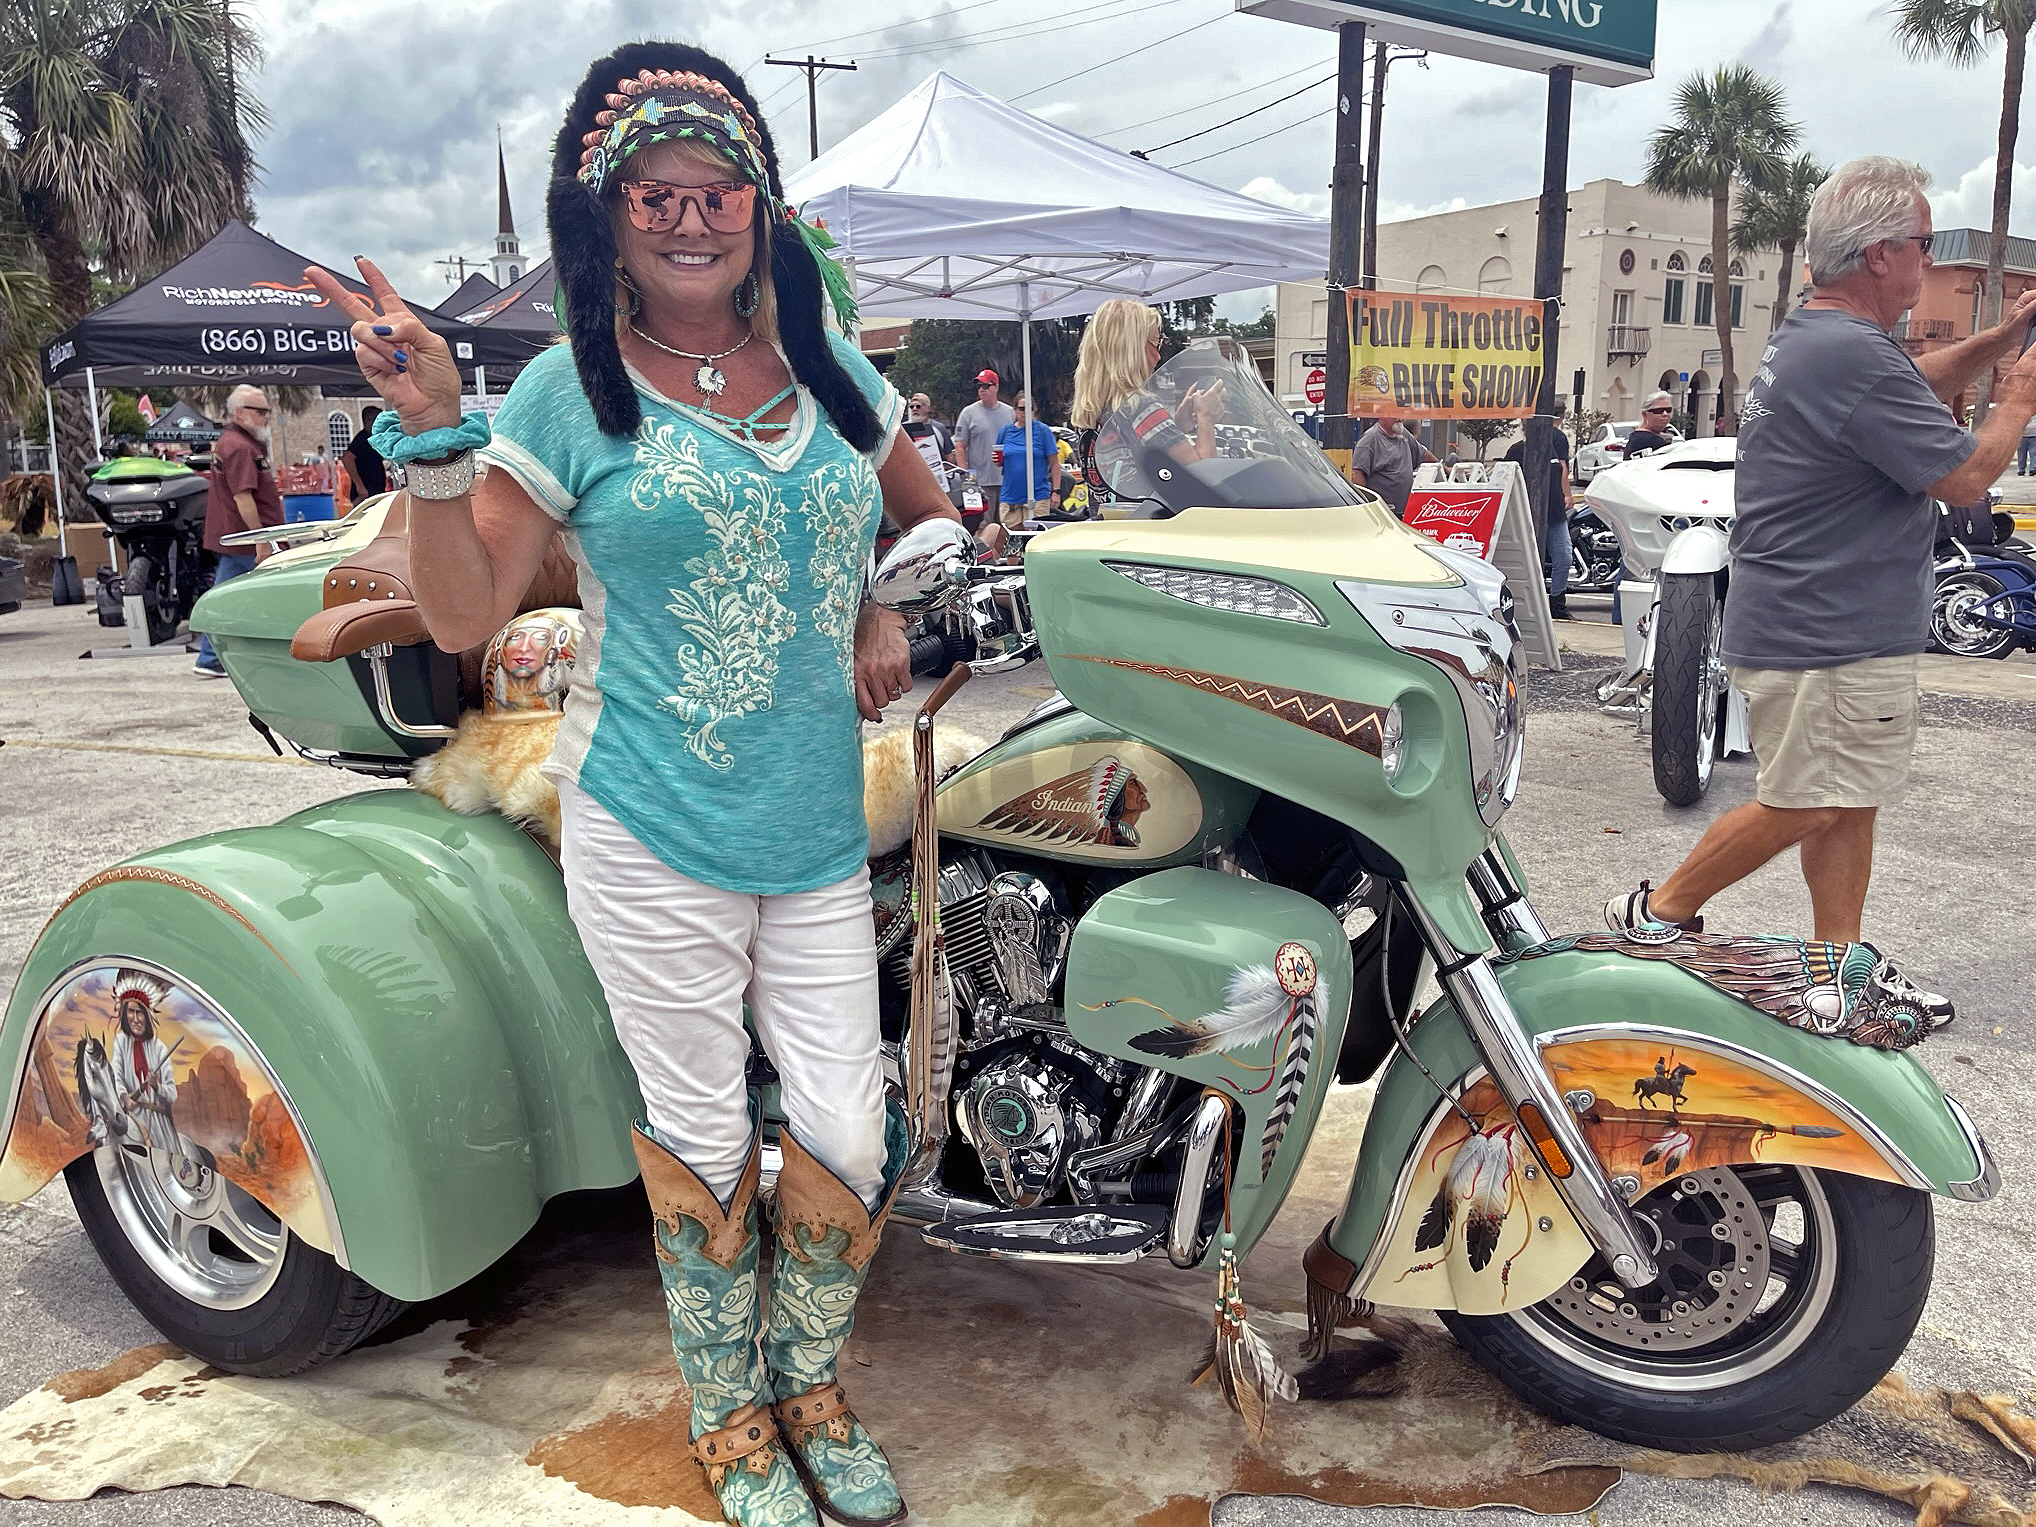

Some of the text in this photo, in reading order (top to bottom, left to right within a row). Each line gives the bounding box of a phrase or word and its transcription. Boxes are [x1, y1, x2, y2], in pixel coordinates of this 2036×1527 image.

[186, 296, 302, 307] MOTORCYCLE LAWYER
[1352, 297, 1541, 352] Full Throttle
[201, 328, 267, 355] (866)
[1309, 390, 1324, 398] ENTER
[1392, 362, 1542, 409] BIKE SHOW
[1421, 503, 1481, 518] Budweiser
[1031, 789, 1094, 814] Indian
[1482, 1334, 1585, 1406] ELITE
